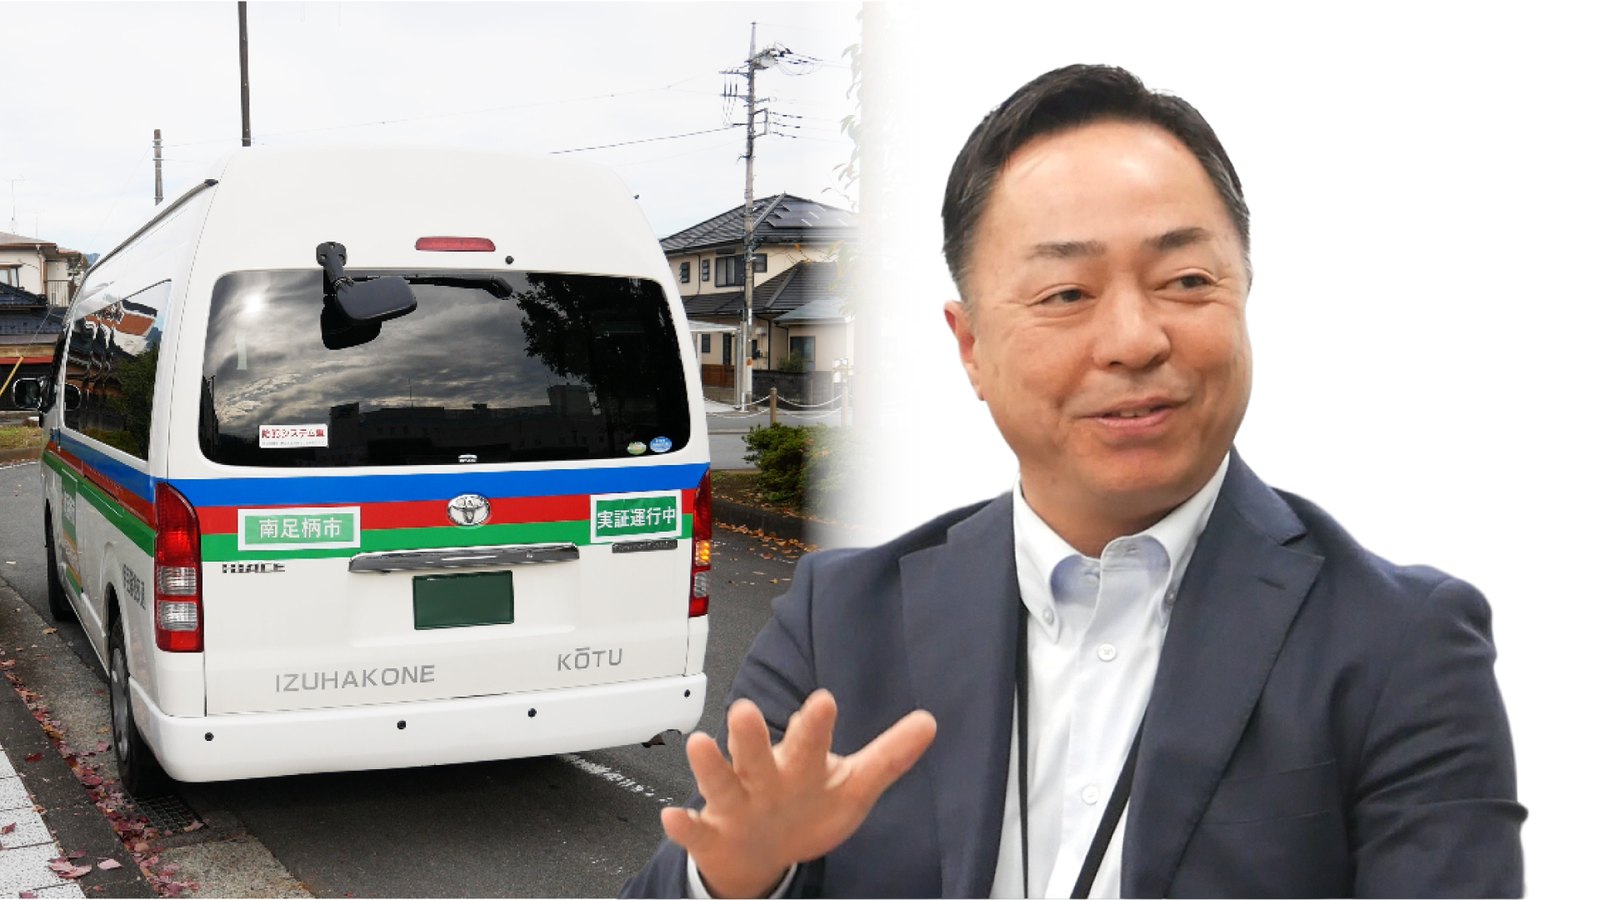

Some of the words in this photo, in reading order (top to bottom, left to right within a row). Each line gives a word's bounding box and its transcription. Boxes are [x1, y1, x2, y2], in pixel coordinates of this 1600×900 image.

[259, 517, 342, 538] 南足柄市
[597, 506, 676, 529] 実証運行中
[276, 665, 435, 692] IZUHAKONE
[558, 647, 622, 671] KŌTU
